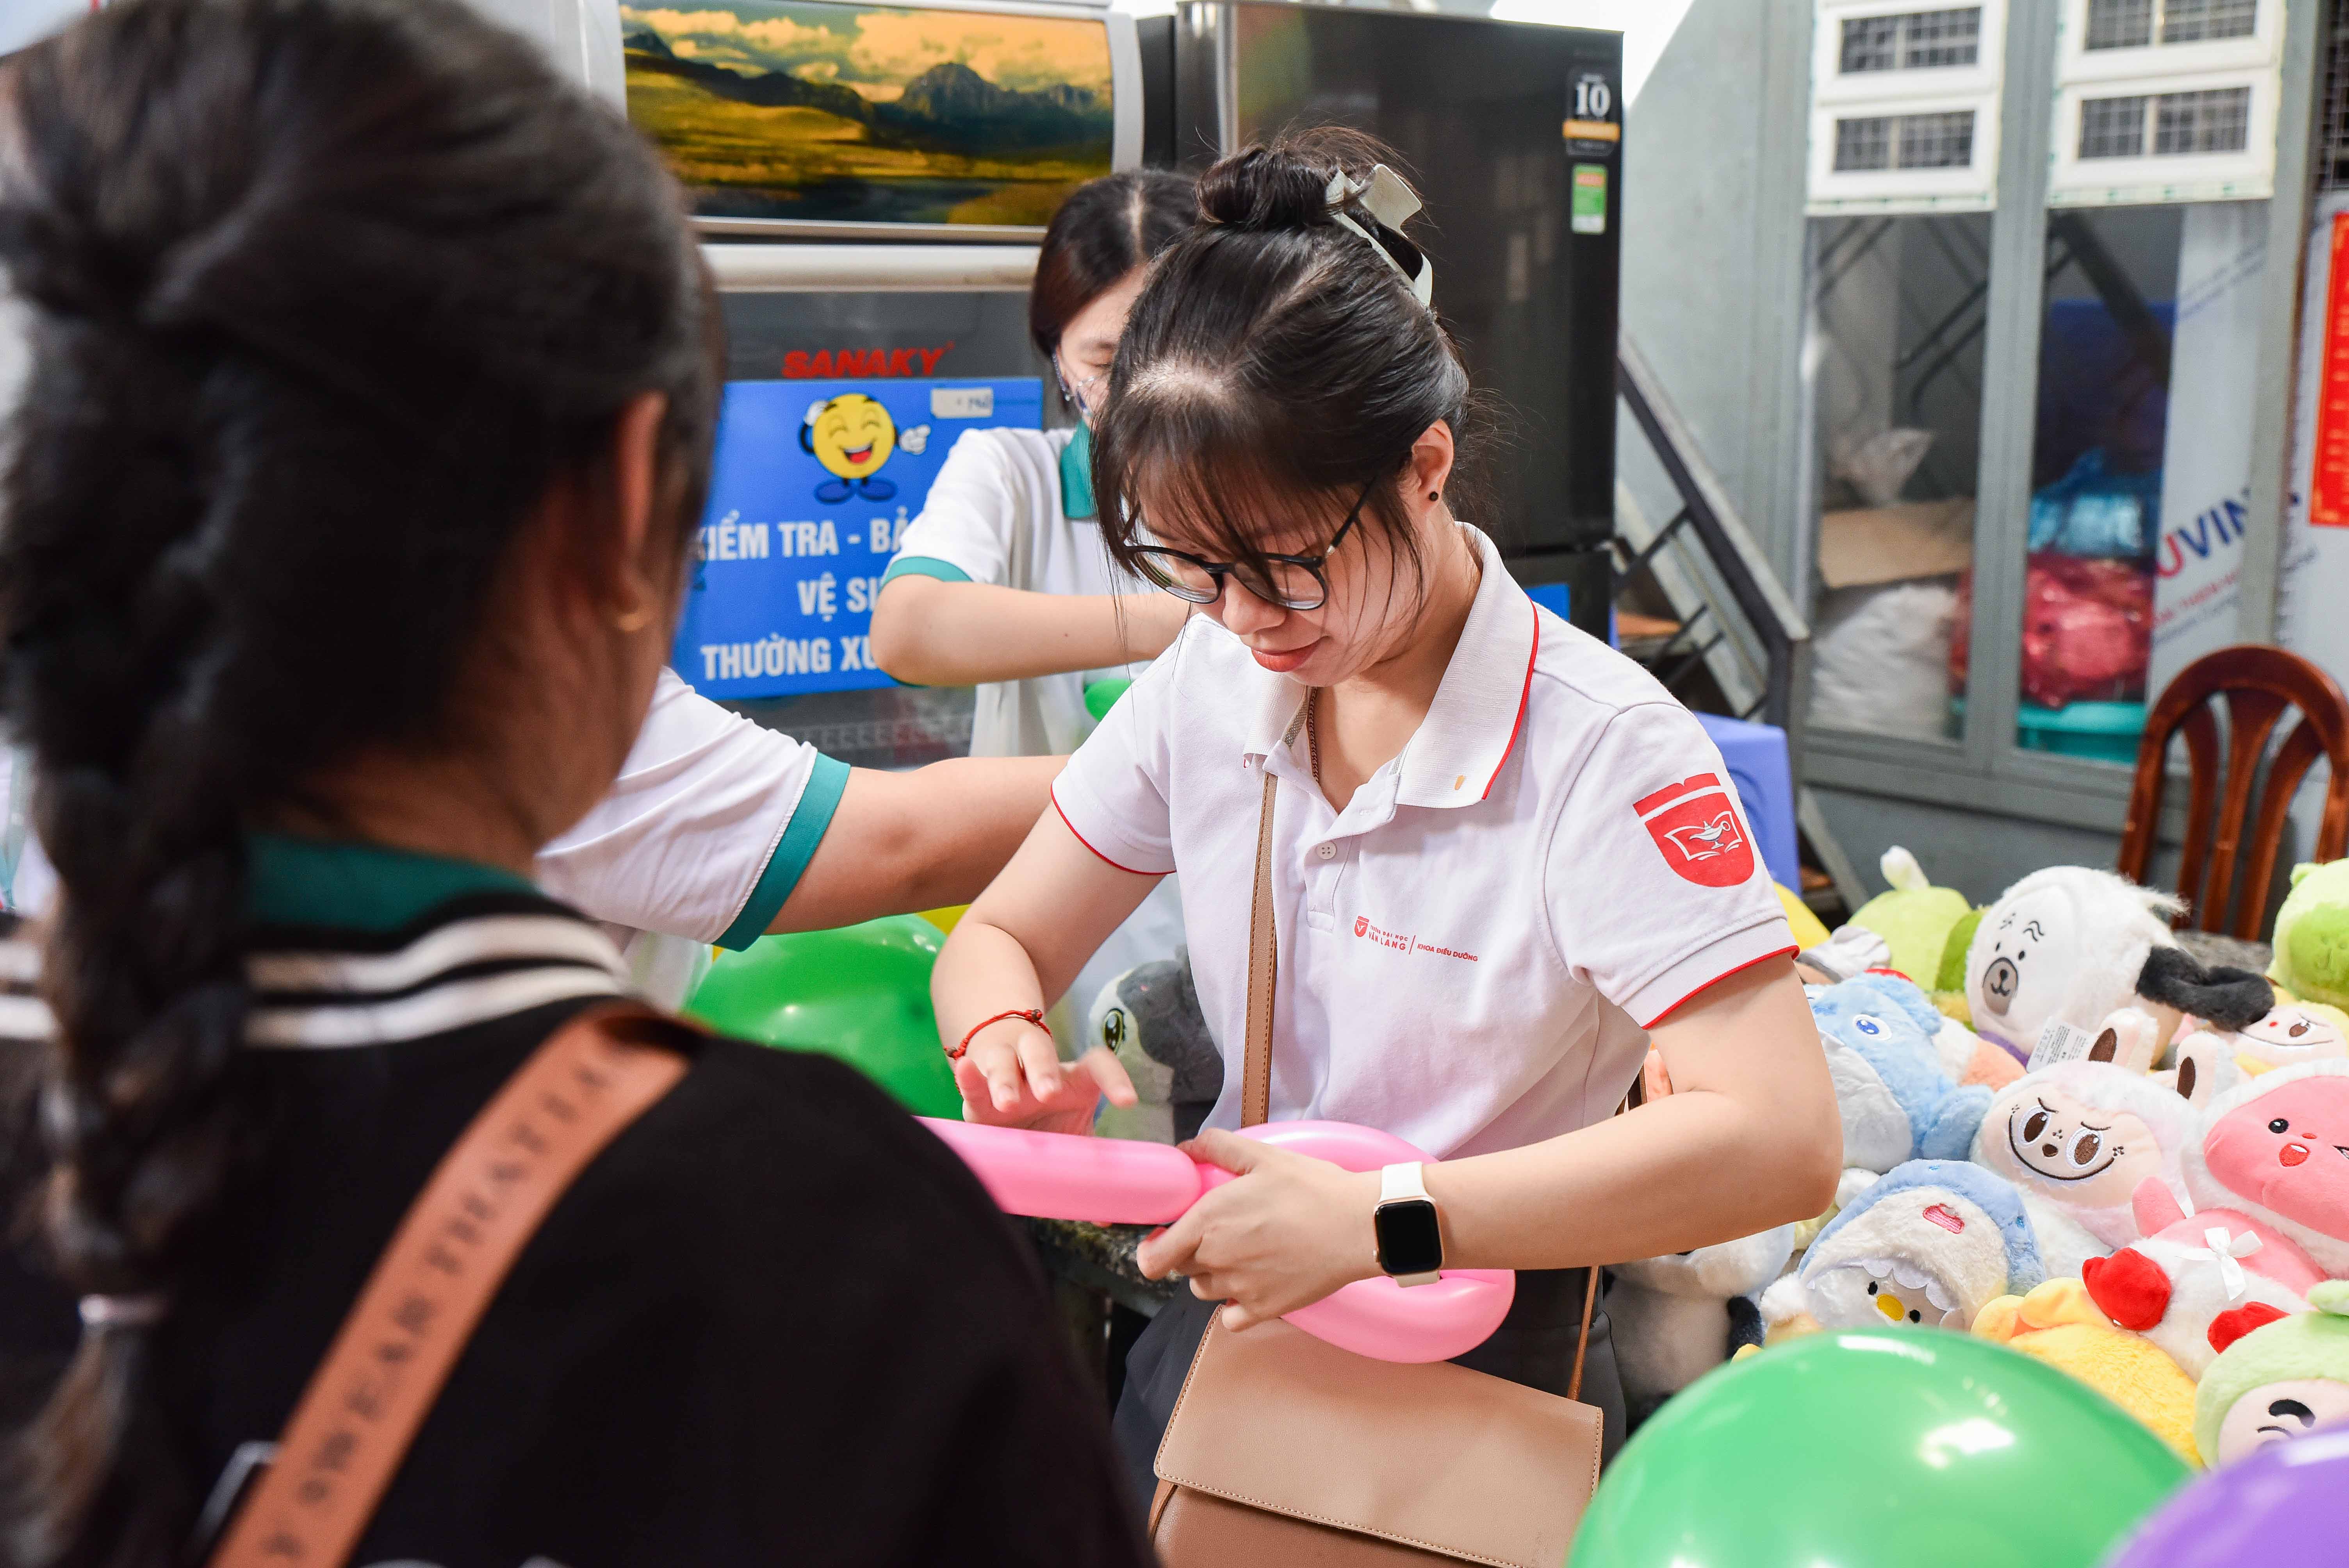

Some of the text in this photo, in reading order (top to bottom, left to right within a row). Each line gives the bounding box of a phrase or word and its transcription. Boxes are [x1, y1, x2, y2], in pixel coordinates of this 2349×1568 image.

[1575, 82, 1611, 117] 10
[782, 347, 945, 378] SANAKY
[778, 521, 839, 557] TRA
[797, 572, 838, 622] VỆ
[701, 632, 832, 680] THƯỜNG
[1381, 938, 1406, 950] LANG
[1417, 943, 1435, 952] KHOA
